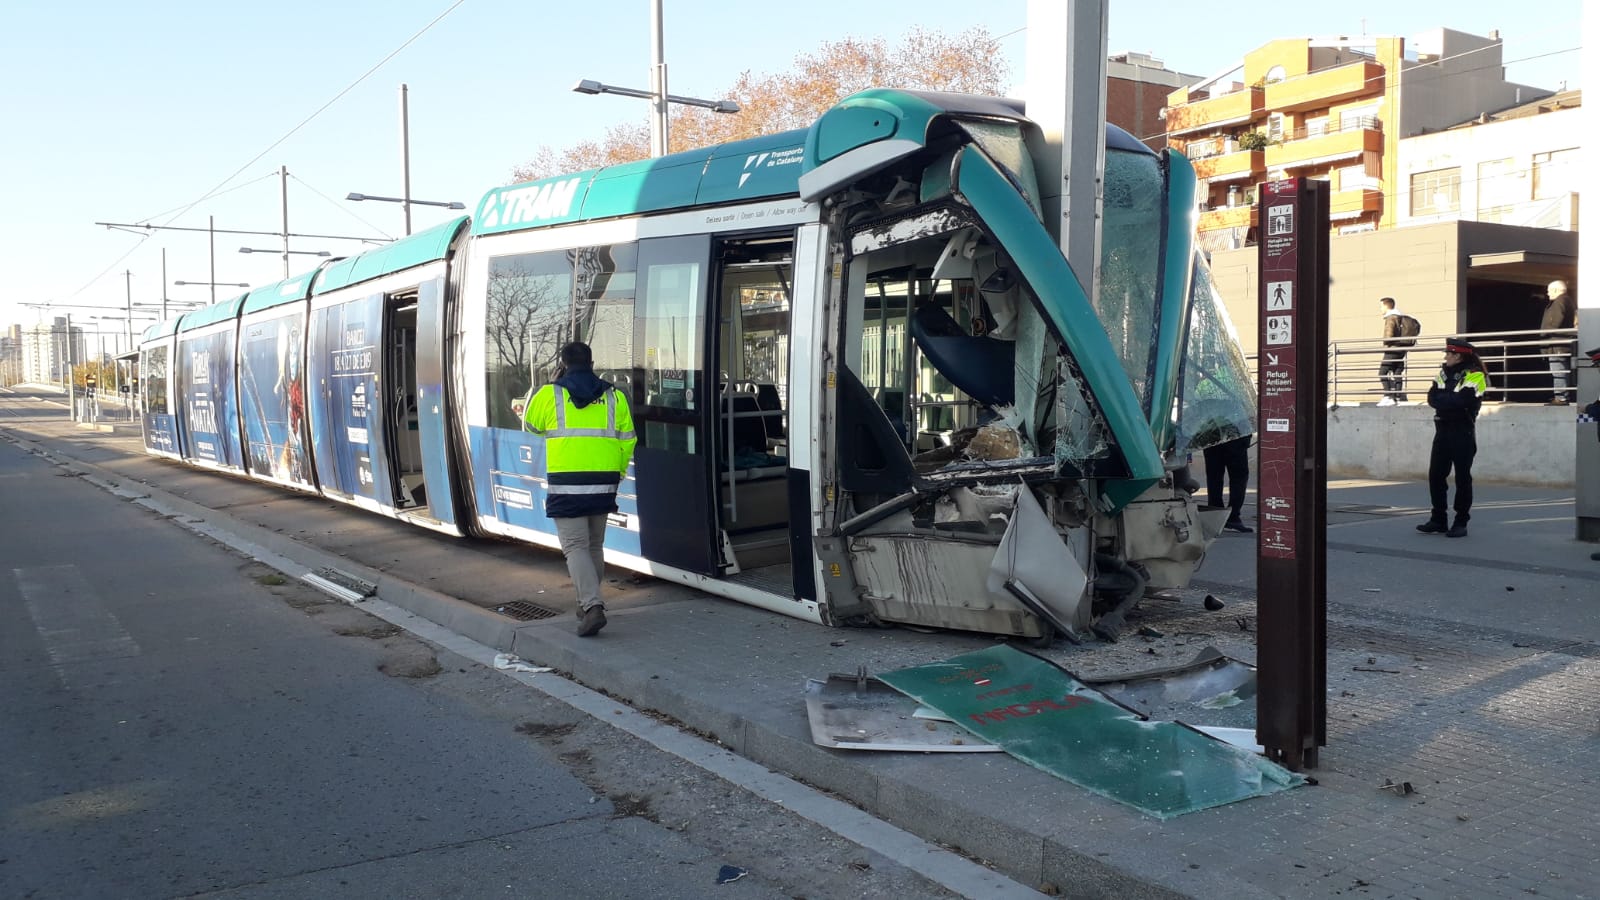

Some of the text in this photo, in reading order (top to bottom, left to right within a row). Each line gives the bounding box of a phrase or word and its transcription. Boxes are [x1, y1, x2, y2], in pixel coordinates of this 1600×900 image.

[767, 155, 804, 167] de Cataluny
[501, 177, 581, 224] TRAM
[1266, 371, 1288, 379] Refugi
[190, 401, 218, 433] AVATAR
